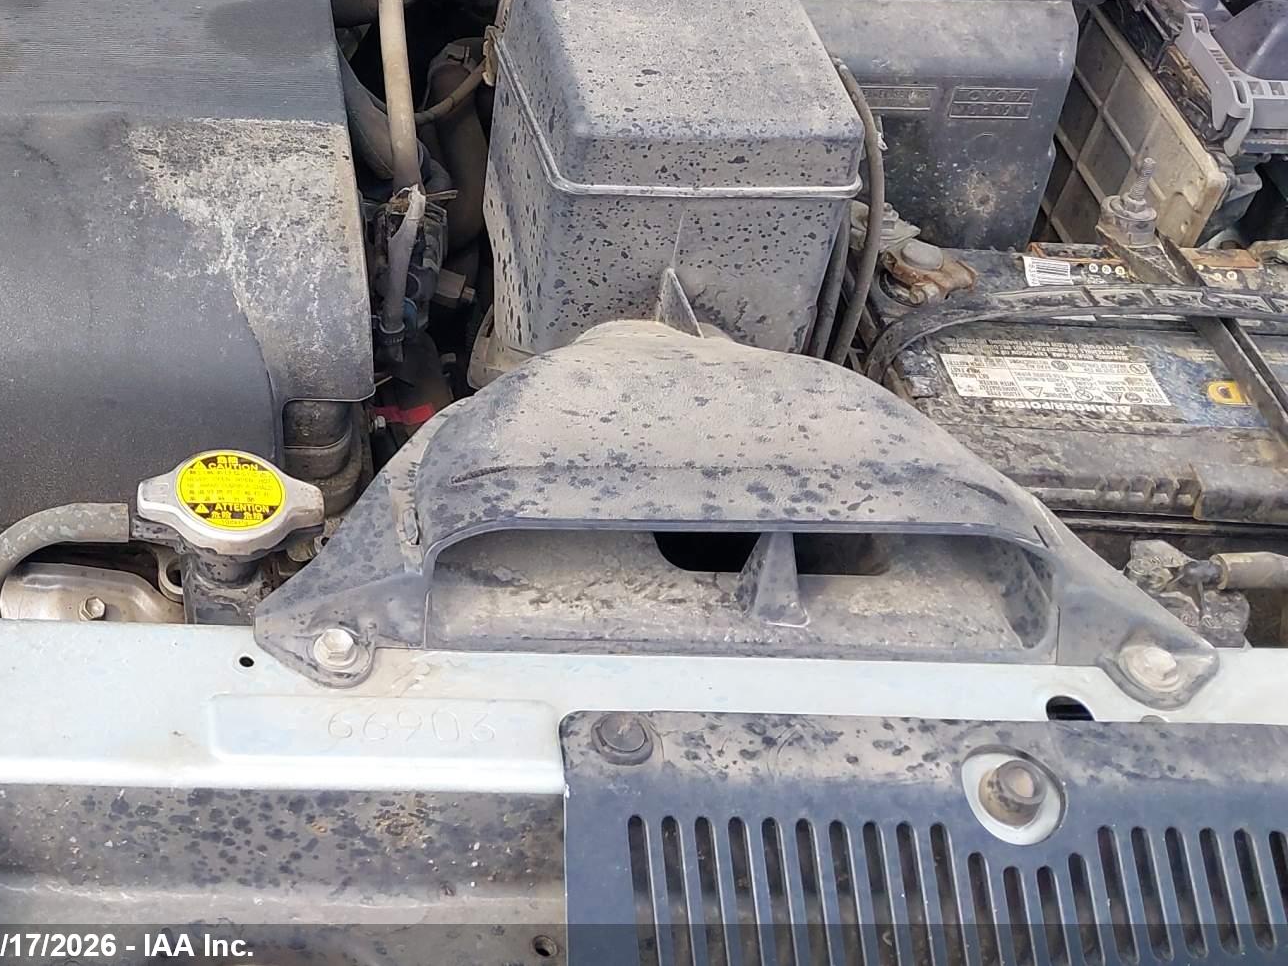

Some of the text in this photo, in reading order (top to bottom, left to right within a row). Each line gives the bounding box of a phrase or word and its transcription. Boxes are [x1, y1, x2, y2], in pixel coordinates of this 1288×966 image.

[992, 399, 1118, 413] DANGER/POISON
[208, 462, 259, 471] CAUTION
[214, 503, 270, 513] ATTENTION
